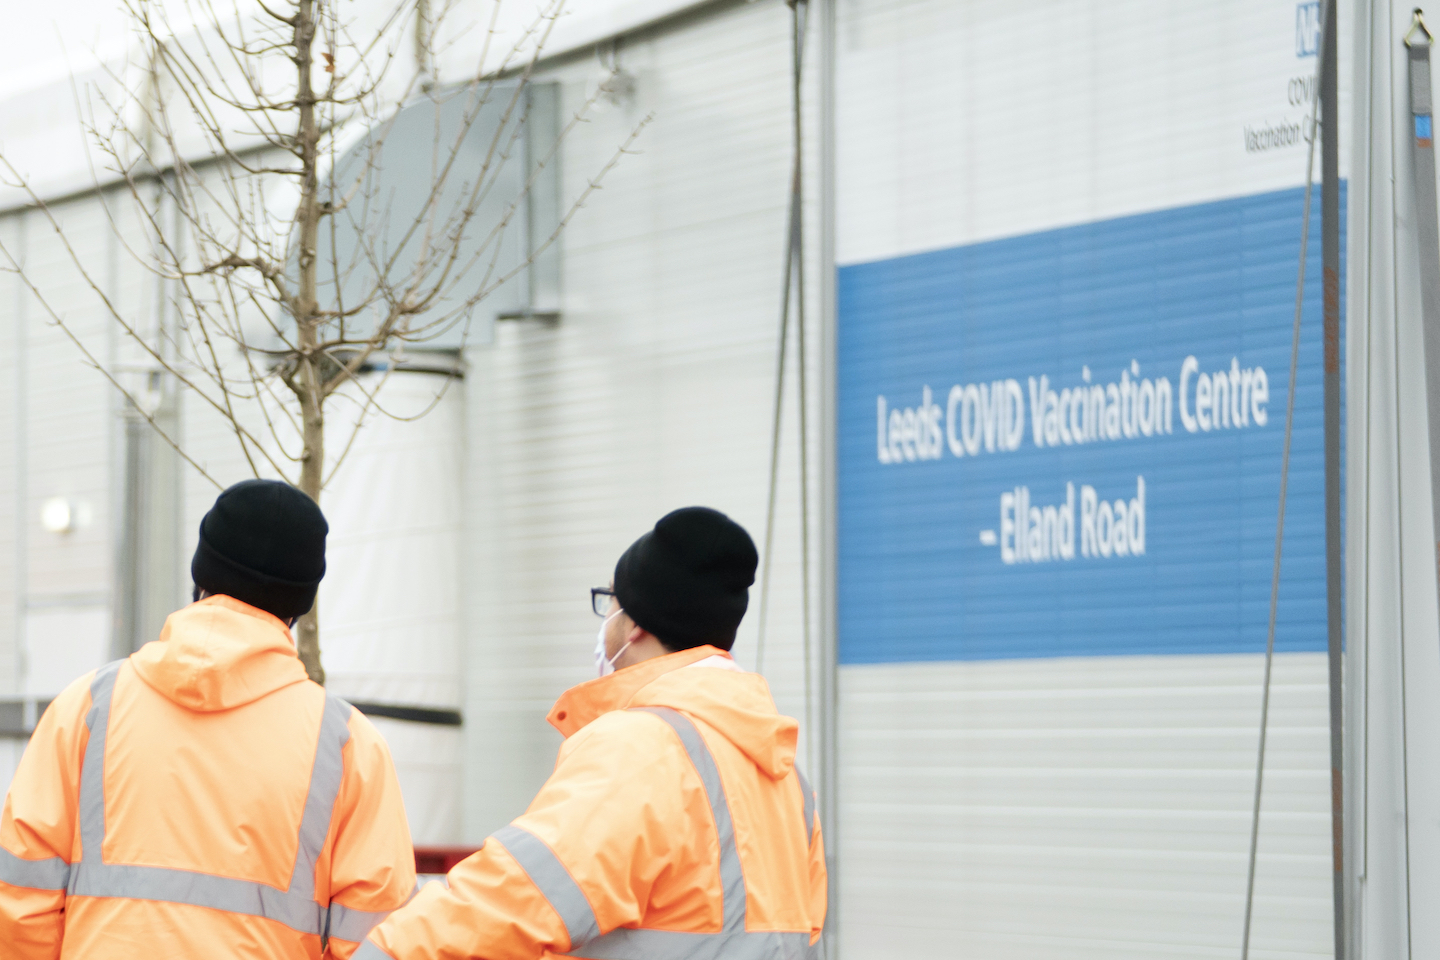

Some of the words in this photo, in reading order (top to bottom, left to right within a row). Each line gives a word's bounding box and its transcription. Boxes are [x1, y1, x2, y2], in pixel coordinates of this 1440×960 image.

[1296, 3, 1320, 56] NH
[1243, 115, 1300, 152] Vaccination
[877, 385, 944, 464] Leeds
[946, 379, 1026, 458] COVID
[1028, 359, 1173, 448] Vaccination
[1178, 355, 1270, 433] Centre
[1080, 475, 1147, 558] Road
